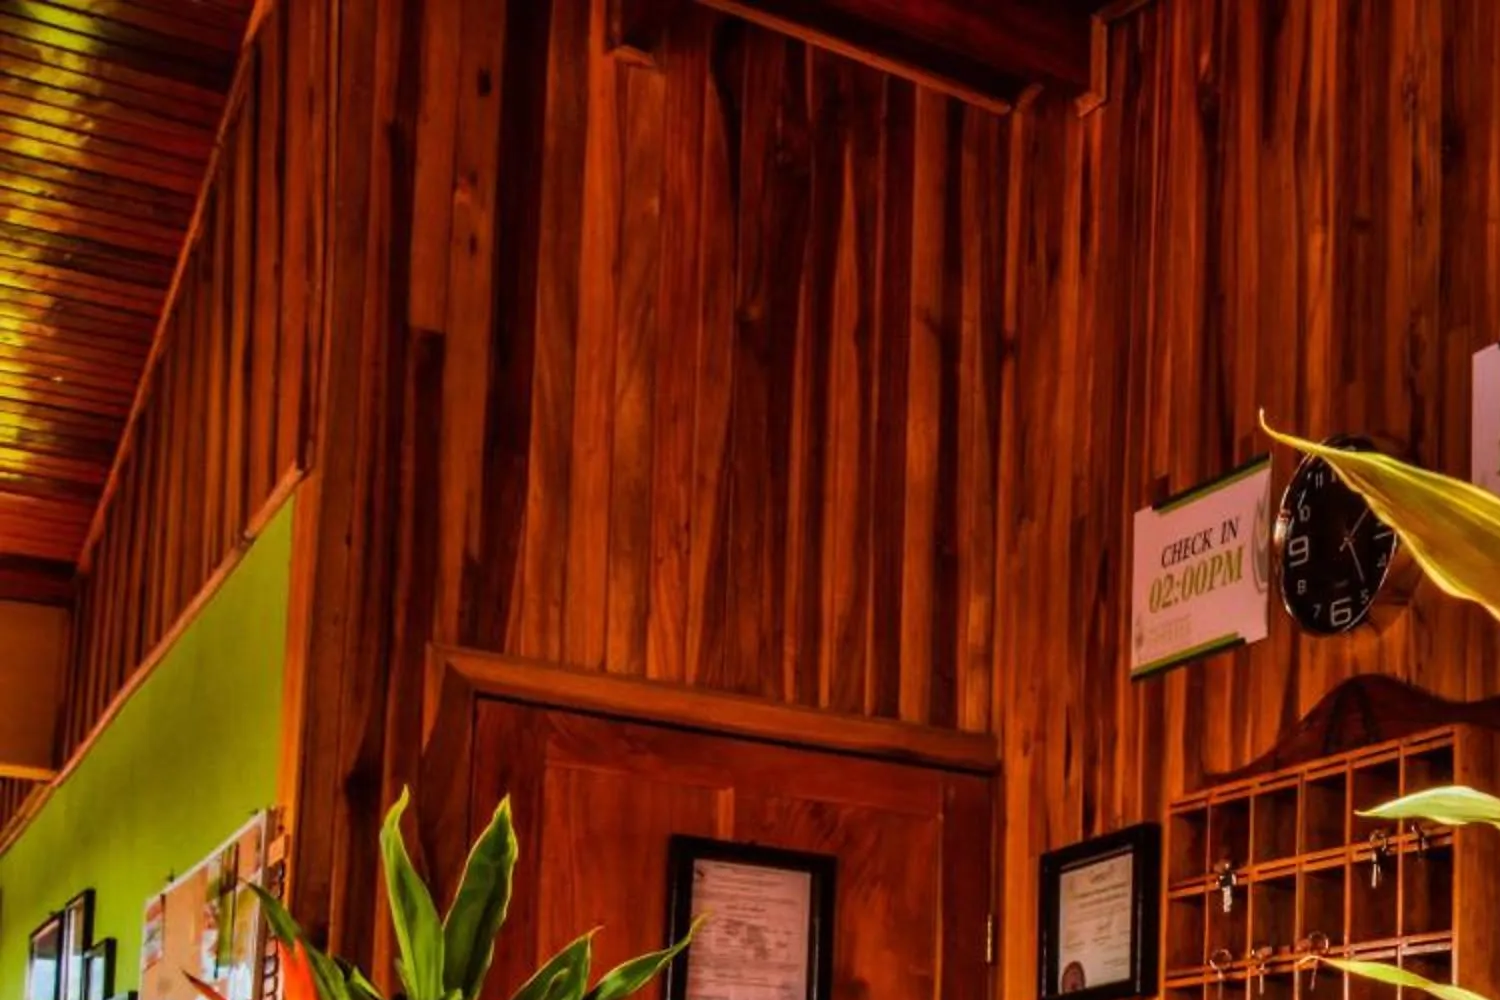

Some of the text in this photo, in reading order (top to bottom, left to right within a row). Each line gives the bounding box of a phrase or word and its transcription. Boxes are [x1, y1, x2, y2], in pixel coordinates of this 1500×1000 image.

[1161, 517, 1240, 568] CHECK IN
[1288, 536, 1310, 568] 9
[1149, 545, 1245, 613] 02:00PM
[1297, 579, 1307, 595] 8
[1313, 603, 1322, 619] 7
[1330, 597, 1352, 628] 6
